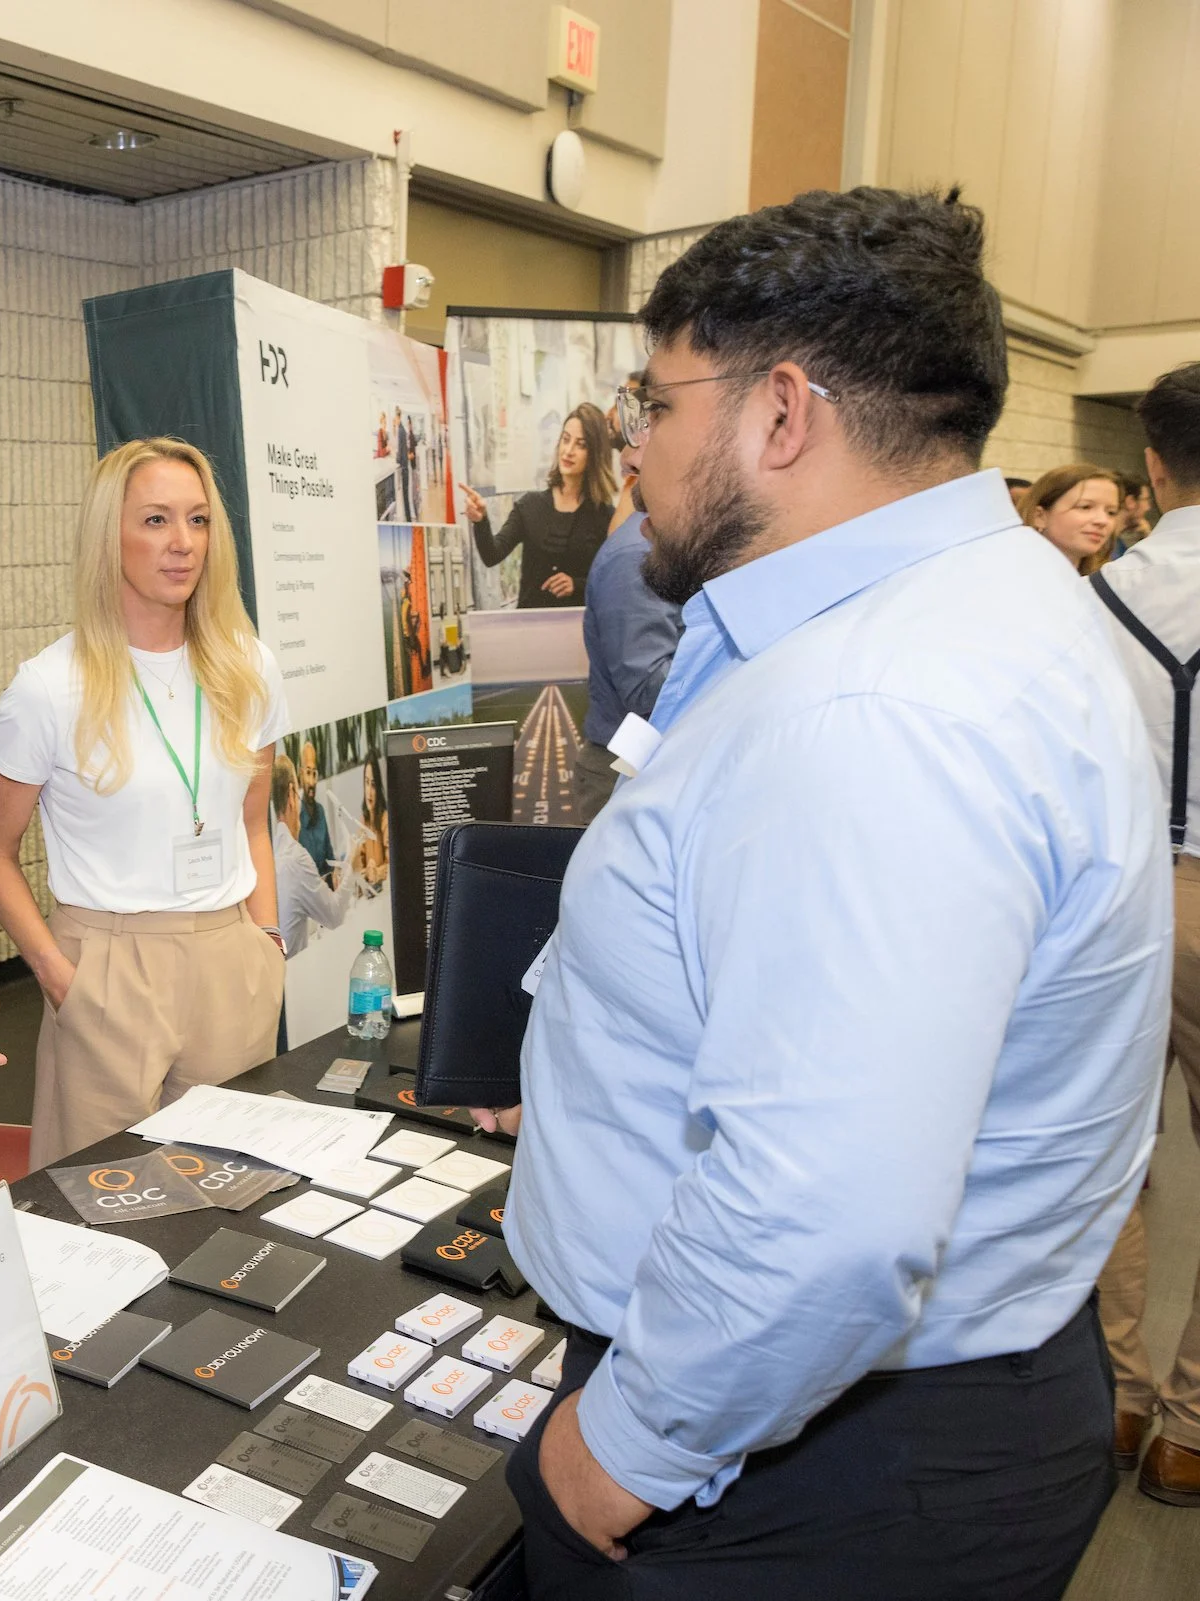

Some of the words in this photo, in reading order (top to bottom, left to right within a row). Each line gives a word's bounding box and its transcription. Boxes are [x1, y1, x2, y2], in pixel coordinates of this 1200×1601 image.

[566, 20, 596, 78] EXIT
[259, 340, 289, 388] HDR
[267, 443, 291, 467] Make
[294, 448, 318, 471] Great
[269, 472, 299, 500] Things
[301, 476, 333, 498] Possible
[426, 737, 447, 747] CDC
[198, 1161, 248, 1190] CDC
[96, 1187, 167, 1208] CDC
[452, 1230, 480, 1248] CDC
[230, 1271, 247, 1282] DID
[240, 1259, 259, 1272] YOU
[251, 1242, 277, 1262] KNOW?
[436, 1304, 456, 1318] CDC
[500, 1327, 519, 1342] CDC
[207, 1358, 226, 1370] DID
[220, 1346, 242, 1360] YOU
[236, 1328, 267, 1349] KNOW?
[387, 1343, 407, 1358] CDC
[444, 1369, 465, 1384] CDC
[515, 1393, 535, 1409] CDC
